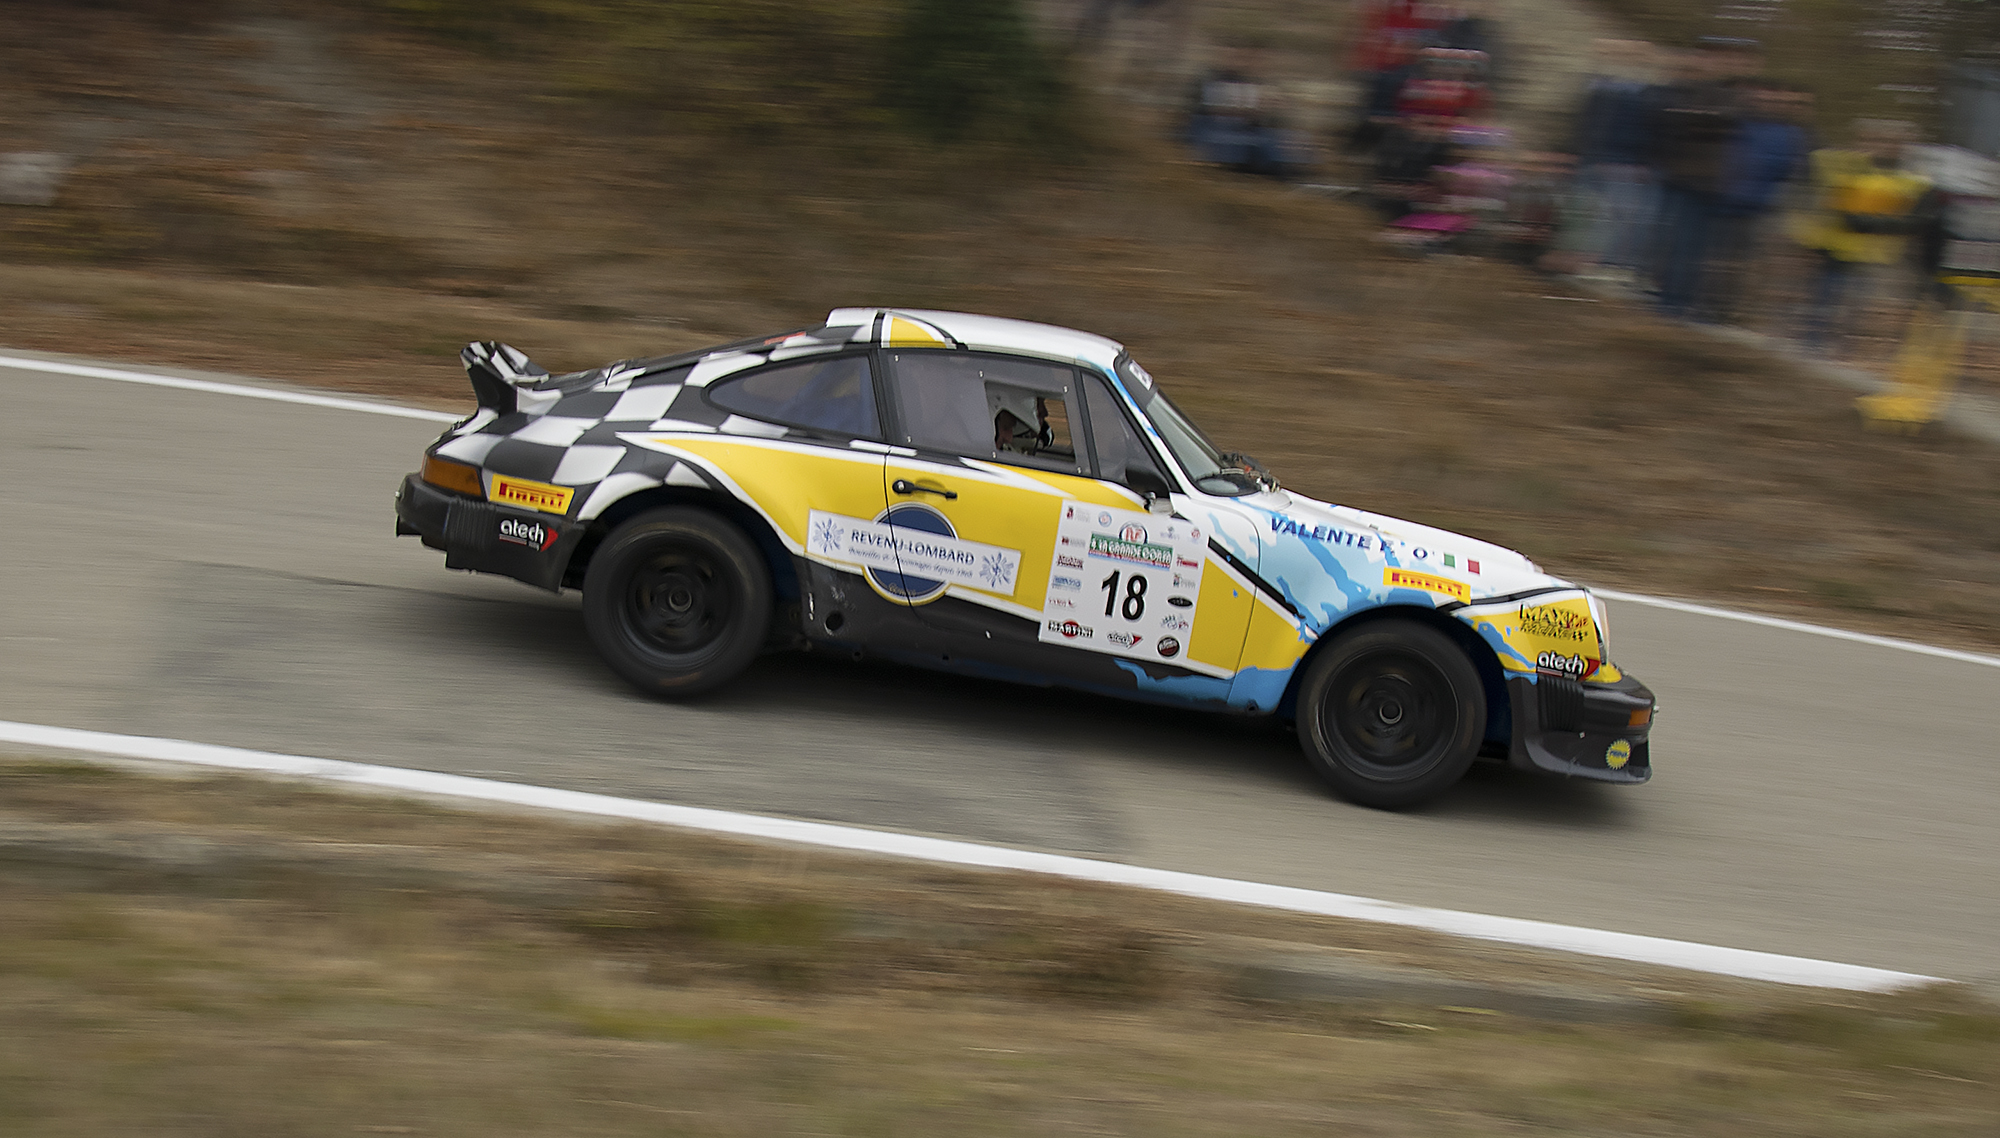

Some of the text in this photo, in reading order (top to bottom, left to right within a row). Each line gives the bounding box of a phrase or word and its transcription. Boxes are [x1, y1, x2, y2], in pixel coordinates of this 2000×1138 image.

[499, 482, 565, 507] PIRELLI
[500, 518, 545, 545] atech
[1271, 517, 1373, 549] VALENTE
[851, 529, 975, 565] REVENU-LOMBARD
[1101, 569, 1148, 621] 18
[1391, 571, 1463, 597] PIRELLI
[1048, 620, 1094, 639] MARTINI
[1538, 652, 1584, 675] atech
